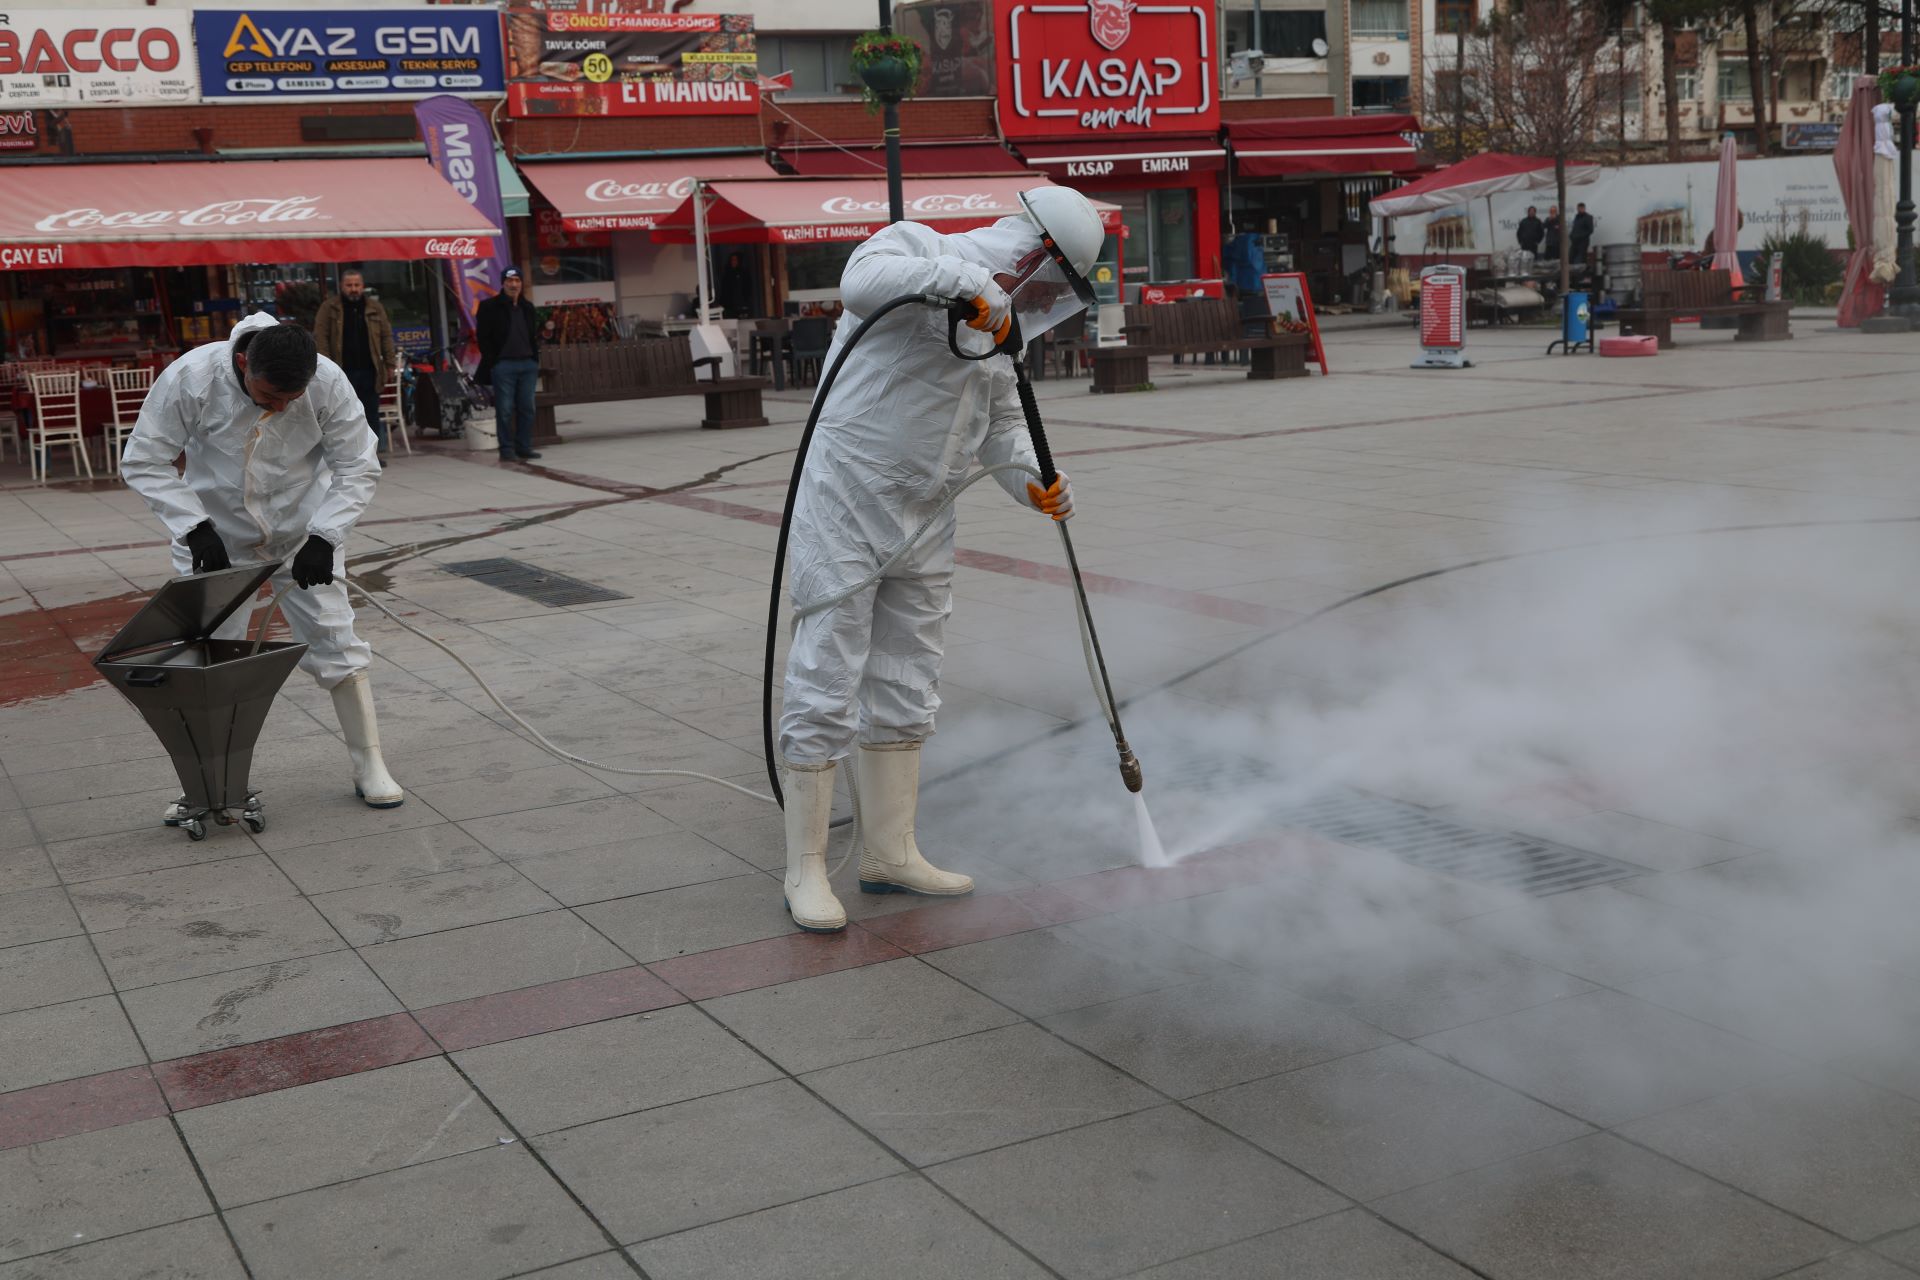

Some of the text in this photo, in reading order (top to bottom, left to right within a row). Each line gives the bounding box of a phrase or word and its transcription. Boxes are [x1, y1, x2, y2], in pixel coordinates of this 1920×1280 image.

[569, 13, 608, 27] ÖNCÜ
[224, 13, 480, 58] AYAZ GSM
[545, 38, 607, 50] TAVUK DÖNER
[230, 61, 312, 72] CEP TELEFONU
[330, 60, 386, 71] AKSESUAR
[402, 58, 478, 70] TEKNİK SERVİS
[588, 58, 608, 74] 50
[627, 55, 659, 64] KOKOREÇ
[1042, 57, 1182, 98] KASAP
[622, 82, 753, 103] ET MANGAL
[1081, 89, 1151, 129] emrah
[1067, 157, 1189, 177] KASAP EMRAH
[35, 195, 323, 232] Coca-Cola
[575, 217, 605, 230] TARİHİ
[606, 217, 618, 228] ET
[619, 216, 656, 228] MANGAL
[782, 225, 871, 240] TARİHİ ET MANGAL
[425, 238, 478, 256] Coca-Cola
[1, 244, 63, 268] ÇAY EVİ
